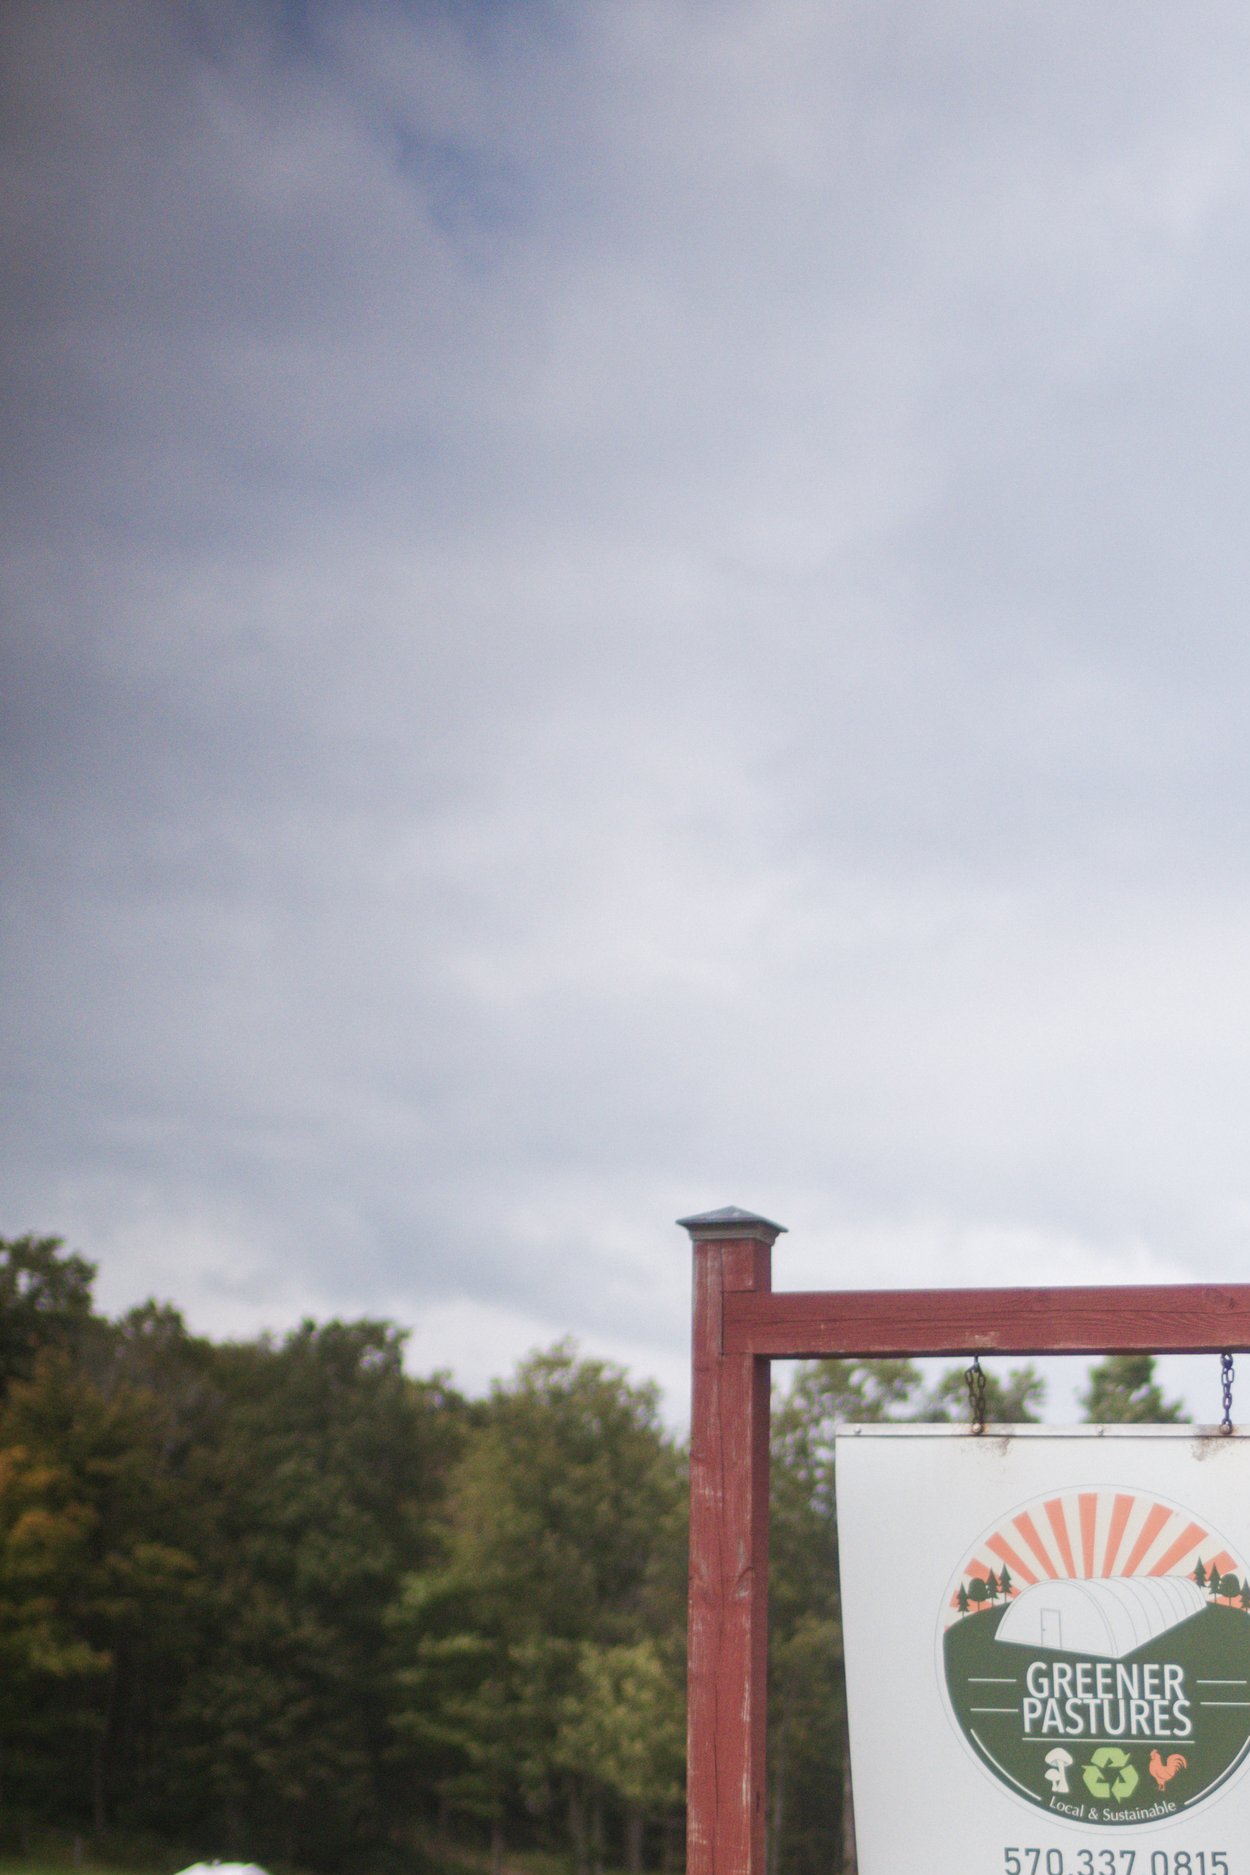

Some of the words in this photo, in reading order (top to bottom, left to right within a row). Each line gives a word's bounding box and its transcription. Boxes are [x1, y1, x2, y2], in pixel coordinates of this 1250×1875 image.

[1026, 1661, 1185, 1700] GREENER
[1022, 1697, 1192, 1737] PASTURES
[1049, 1795, 1085, 1818] Local
[1088, 1807, 1099, 1820] &
[1102, 1800, 1177, 1821] Sustainable
